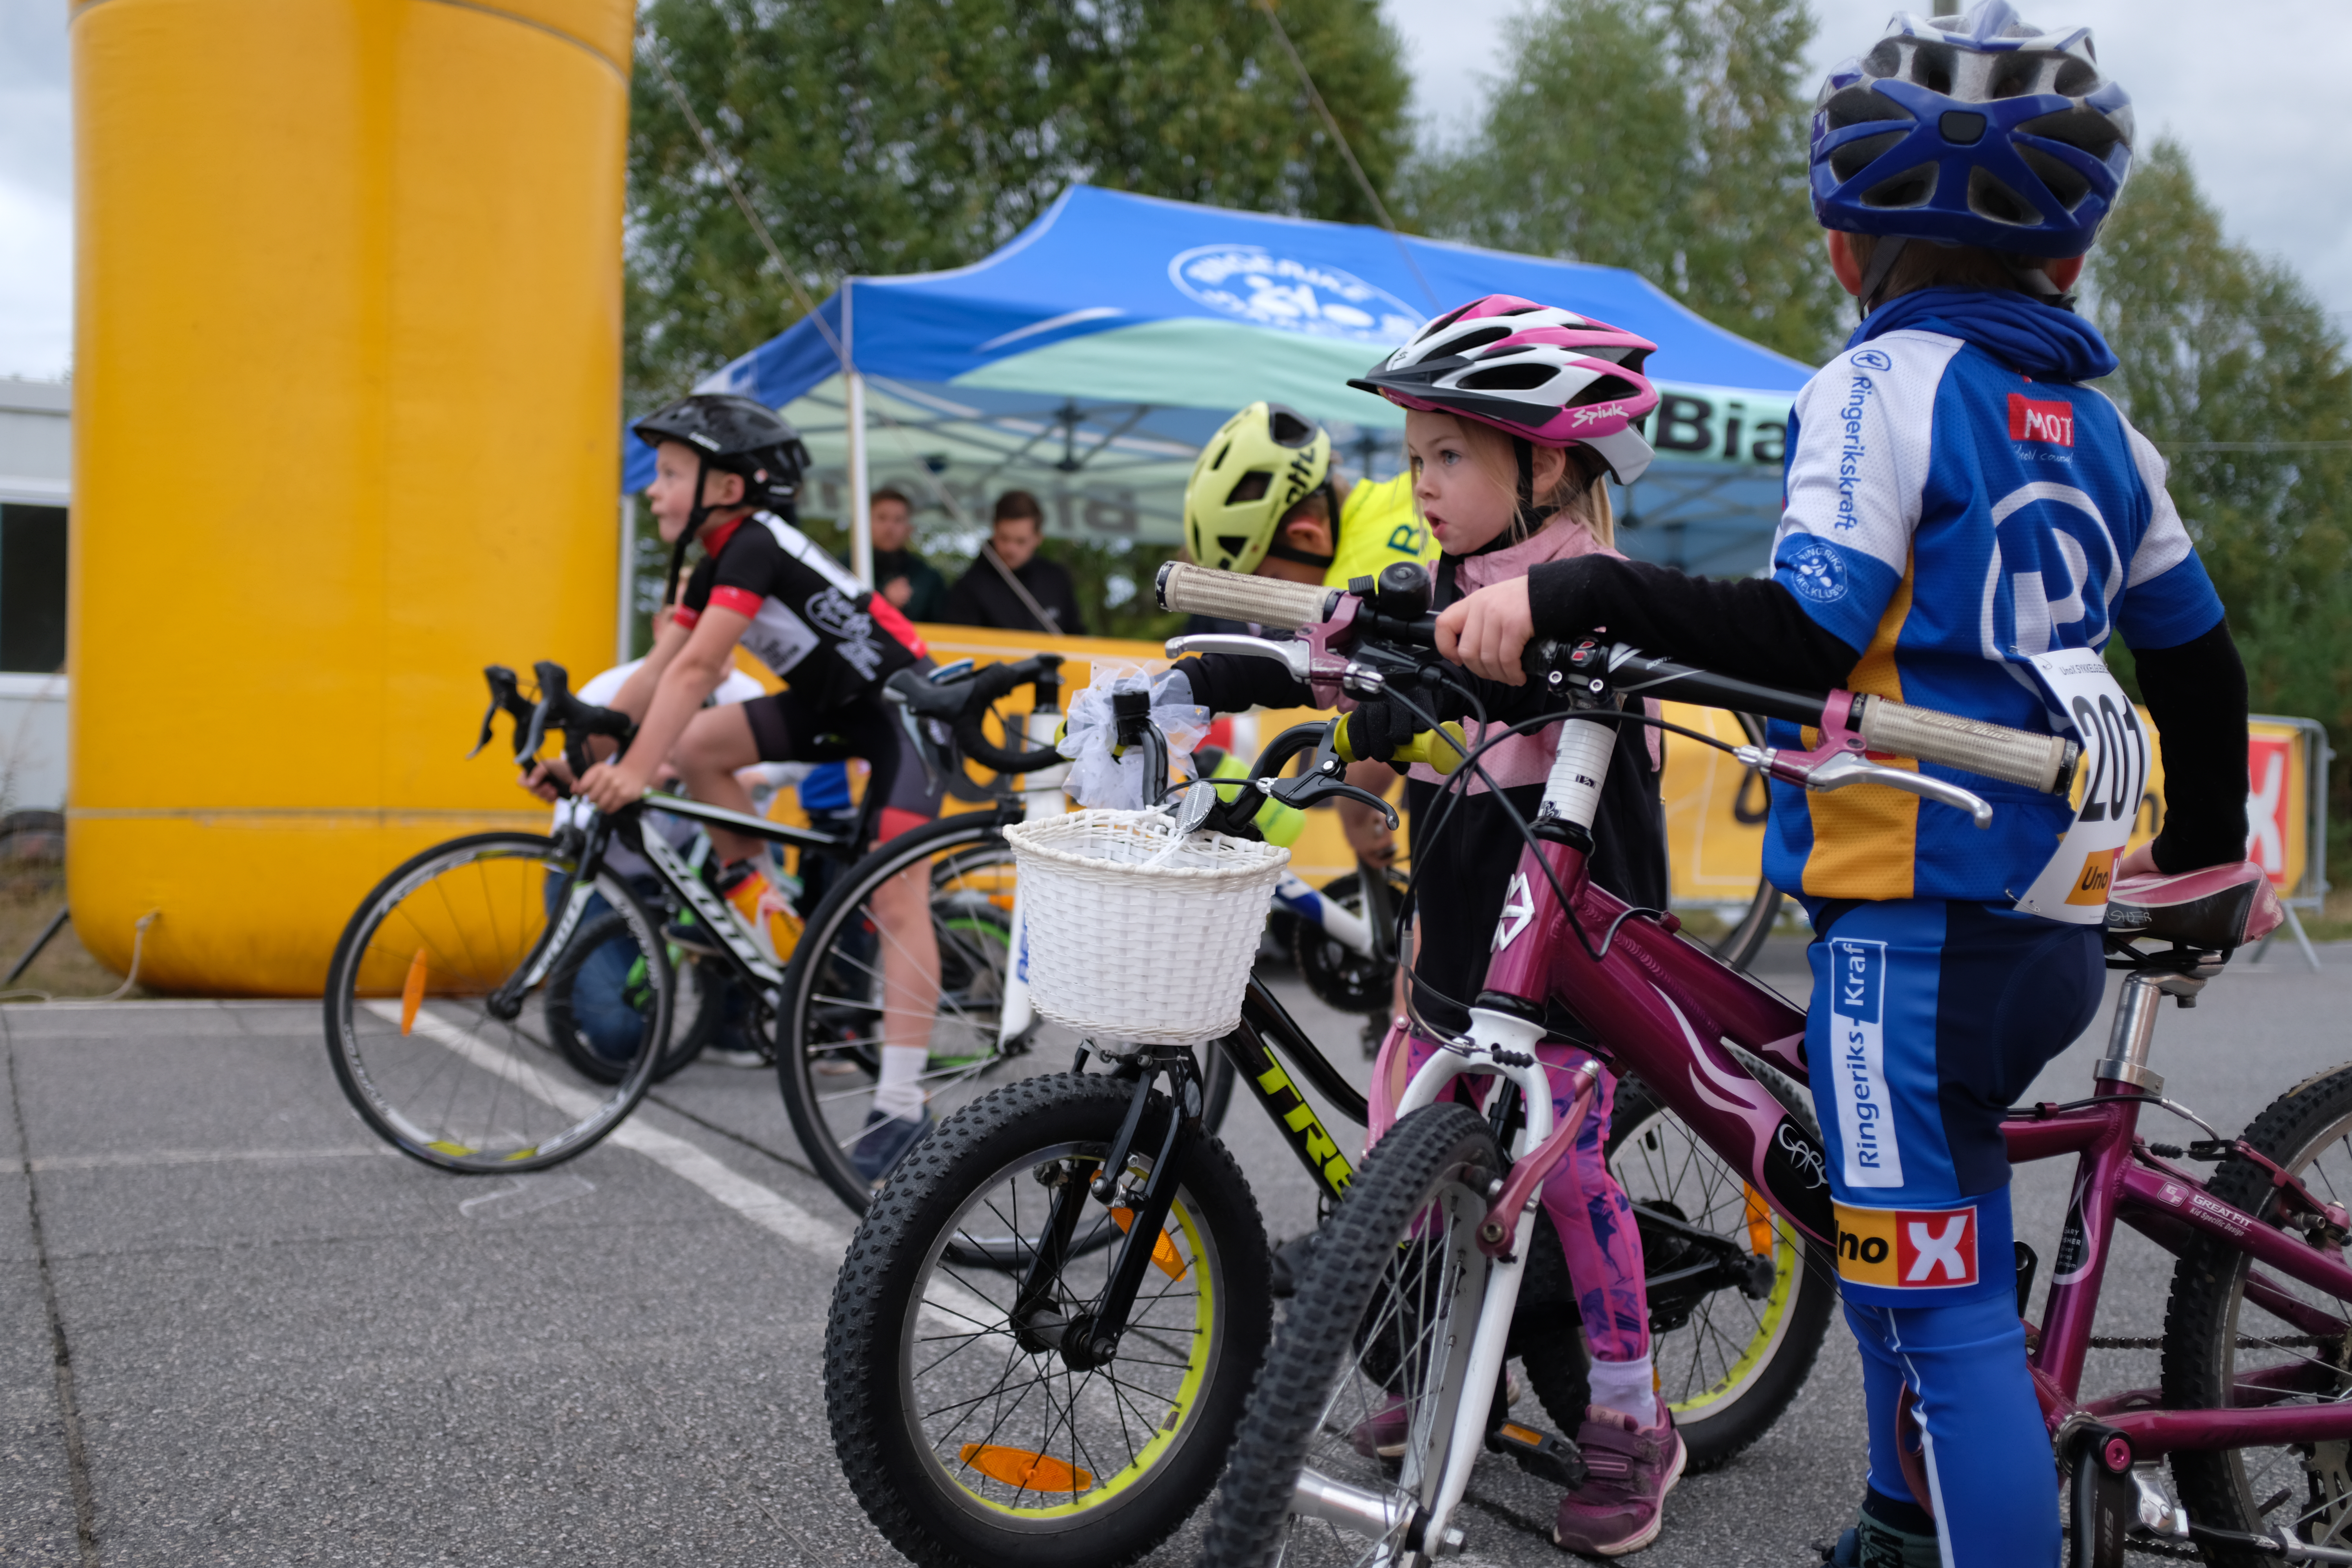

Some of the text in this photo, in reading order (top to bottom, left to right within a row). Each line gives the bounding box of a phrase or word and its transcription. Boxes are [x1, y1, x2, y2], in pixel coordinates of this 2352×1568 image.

[1571, 403, 1629, 428] Spiuk
[2025, 408, 2072, 446] MOT
[1834, 376, 1873, 530] Ringerikskraft
[2072, 694, 2145, 822] 201
[2081, 866, 2109, 891] Uno
[2189, 1207, 2245, 1237] Kid Specific Design
[2193, 1194, 2252, 1227] GREAT FIT
[1837, 1220, 1889, 1264] no
[2062, 1237, 2082, 1246] ISHER
[2063, 1226, 2080, 1236] GARY
